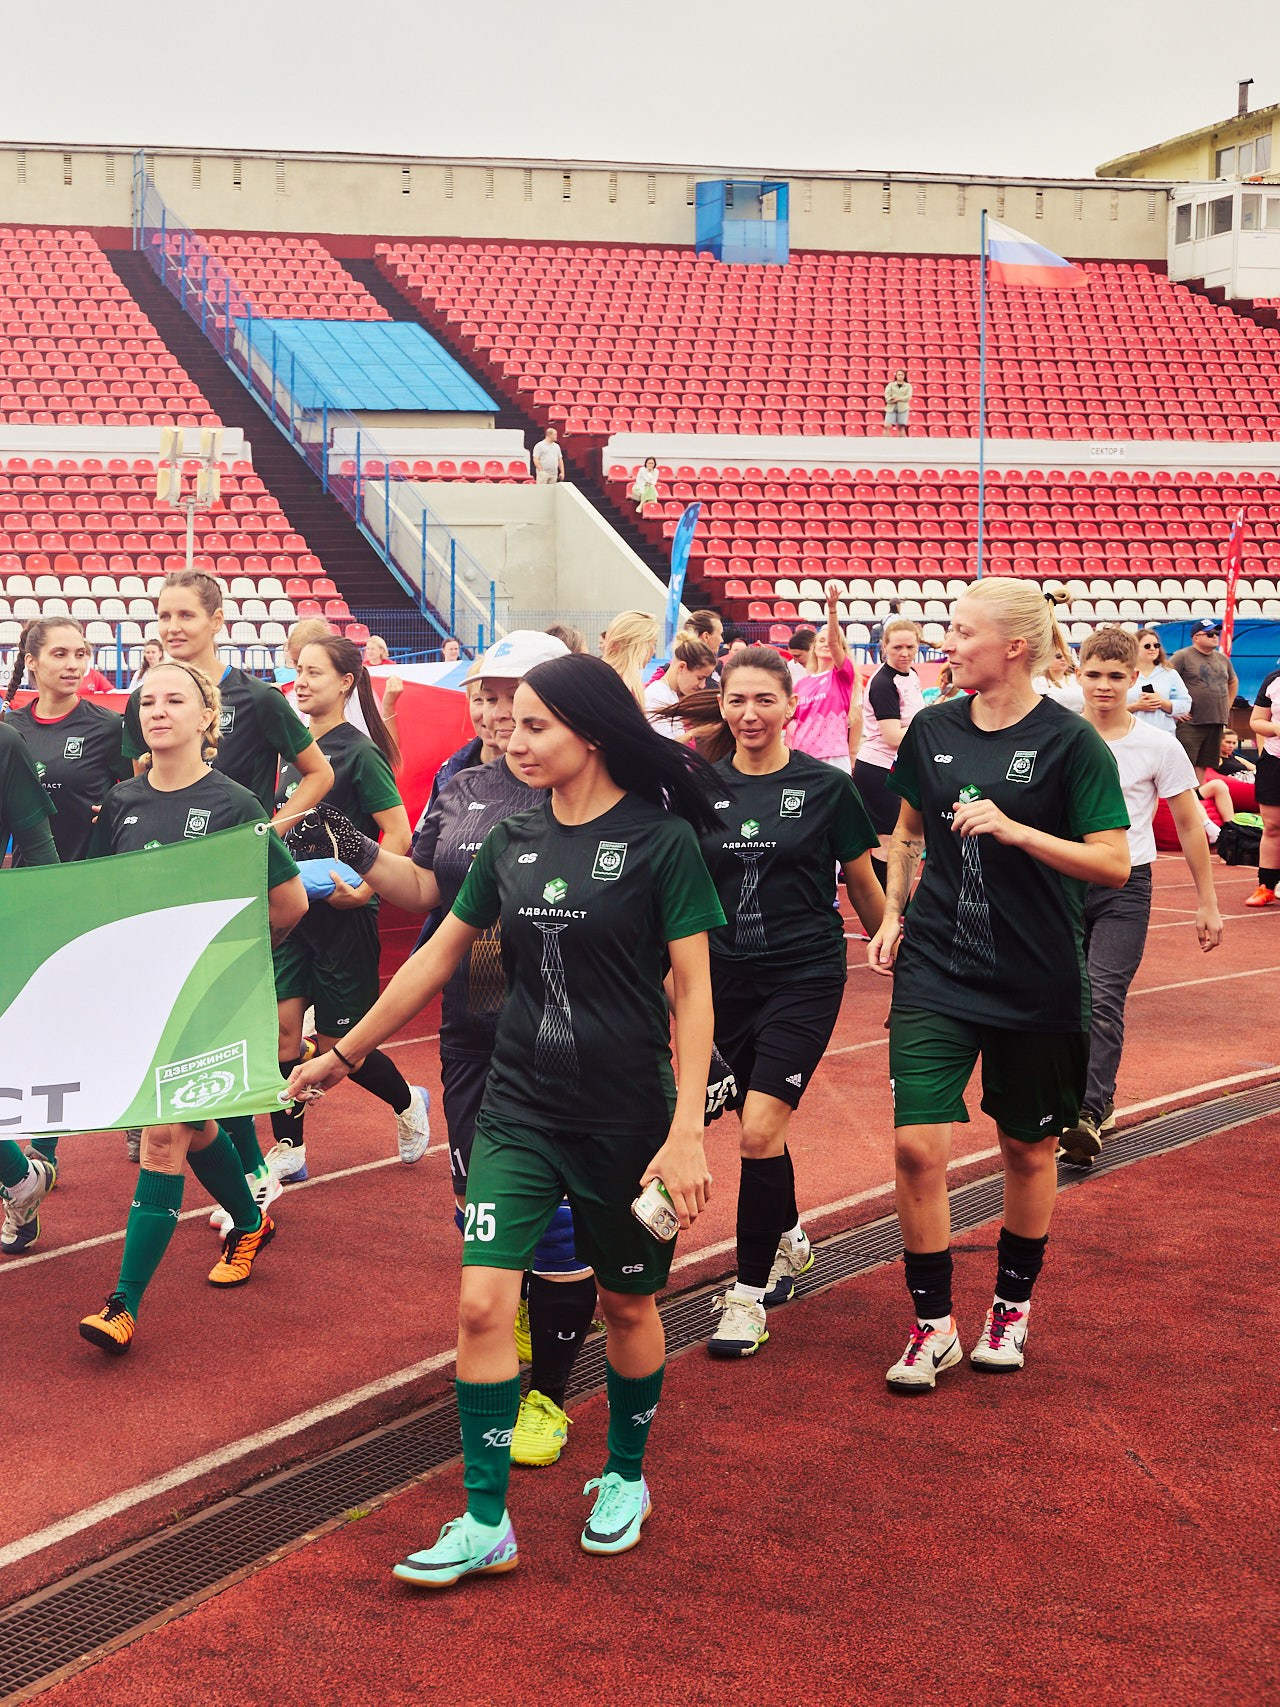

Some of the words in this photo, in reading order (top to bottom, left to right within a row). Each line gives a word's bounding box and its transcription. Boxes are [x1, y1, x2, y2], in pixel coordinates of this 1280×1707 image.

[933, 754, 954, 764] GS
[714, 800, 731, 810] GS
[722, 841, 777, 850] АДВАПЛАСТ
[517, 852, 539, 864] GS
[518, 907, 588, 919] АДВАПЛАСТ
[336, 1017, 350, 1025] GS
[163, 1047, 240, 1080] ДЗЕРЖИНСК
[464, 1202, 496, 1242] 25
[621, 1263, 645, 1274] GS
